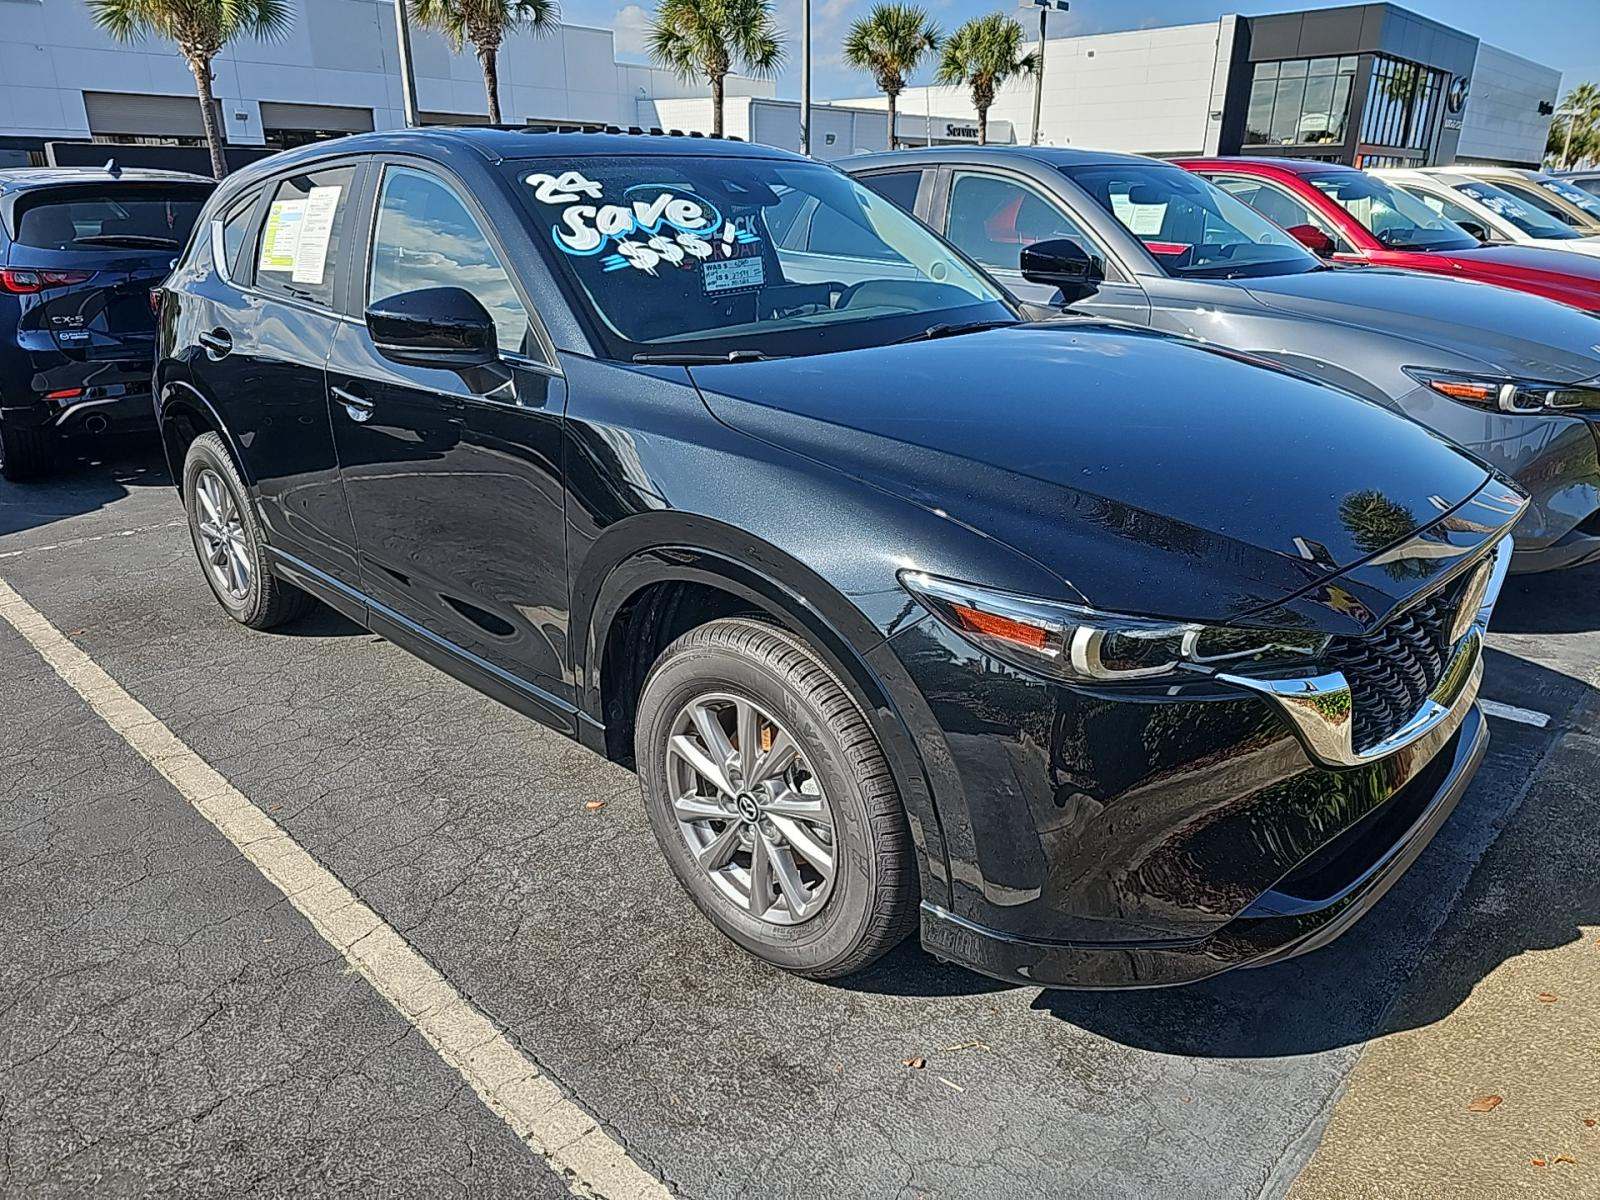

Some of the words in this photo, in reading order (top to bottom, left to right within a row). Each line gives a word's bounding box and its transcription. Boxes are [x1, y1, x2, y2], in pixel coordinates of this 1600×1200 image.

[946, 124, 978, 138] Service
[525, 171, 603, 204] 24
[556, 193, 706, 251] Save
[52, 315, 84, 323] CX-5
